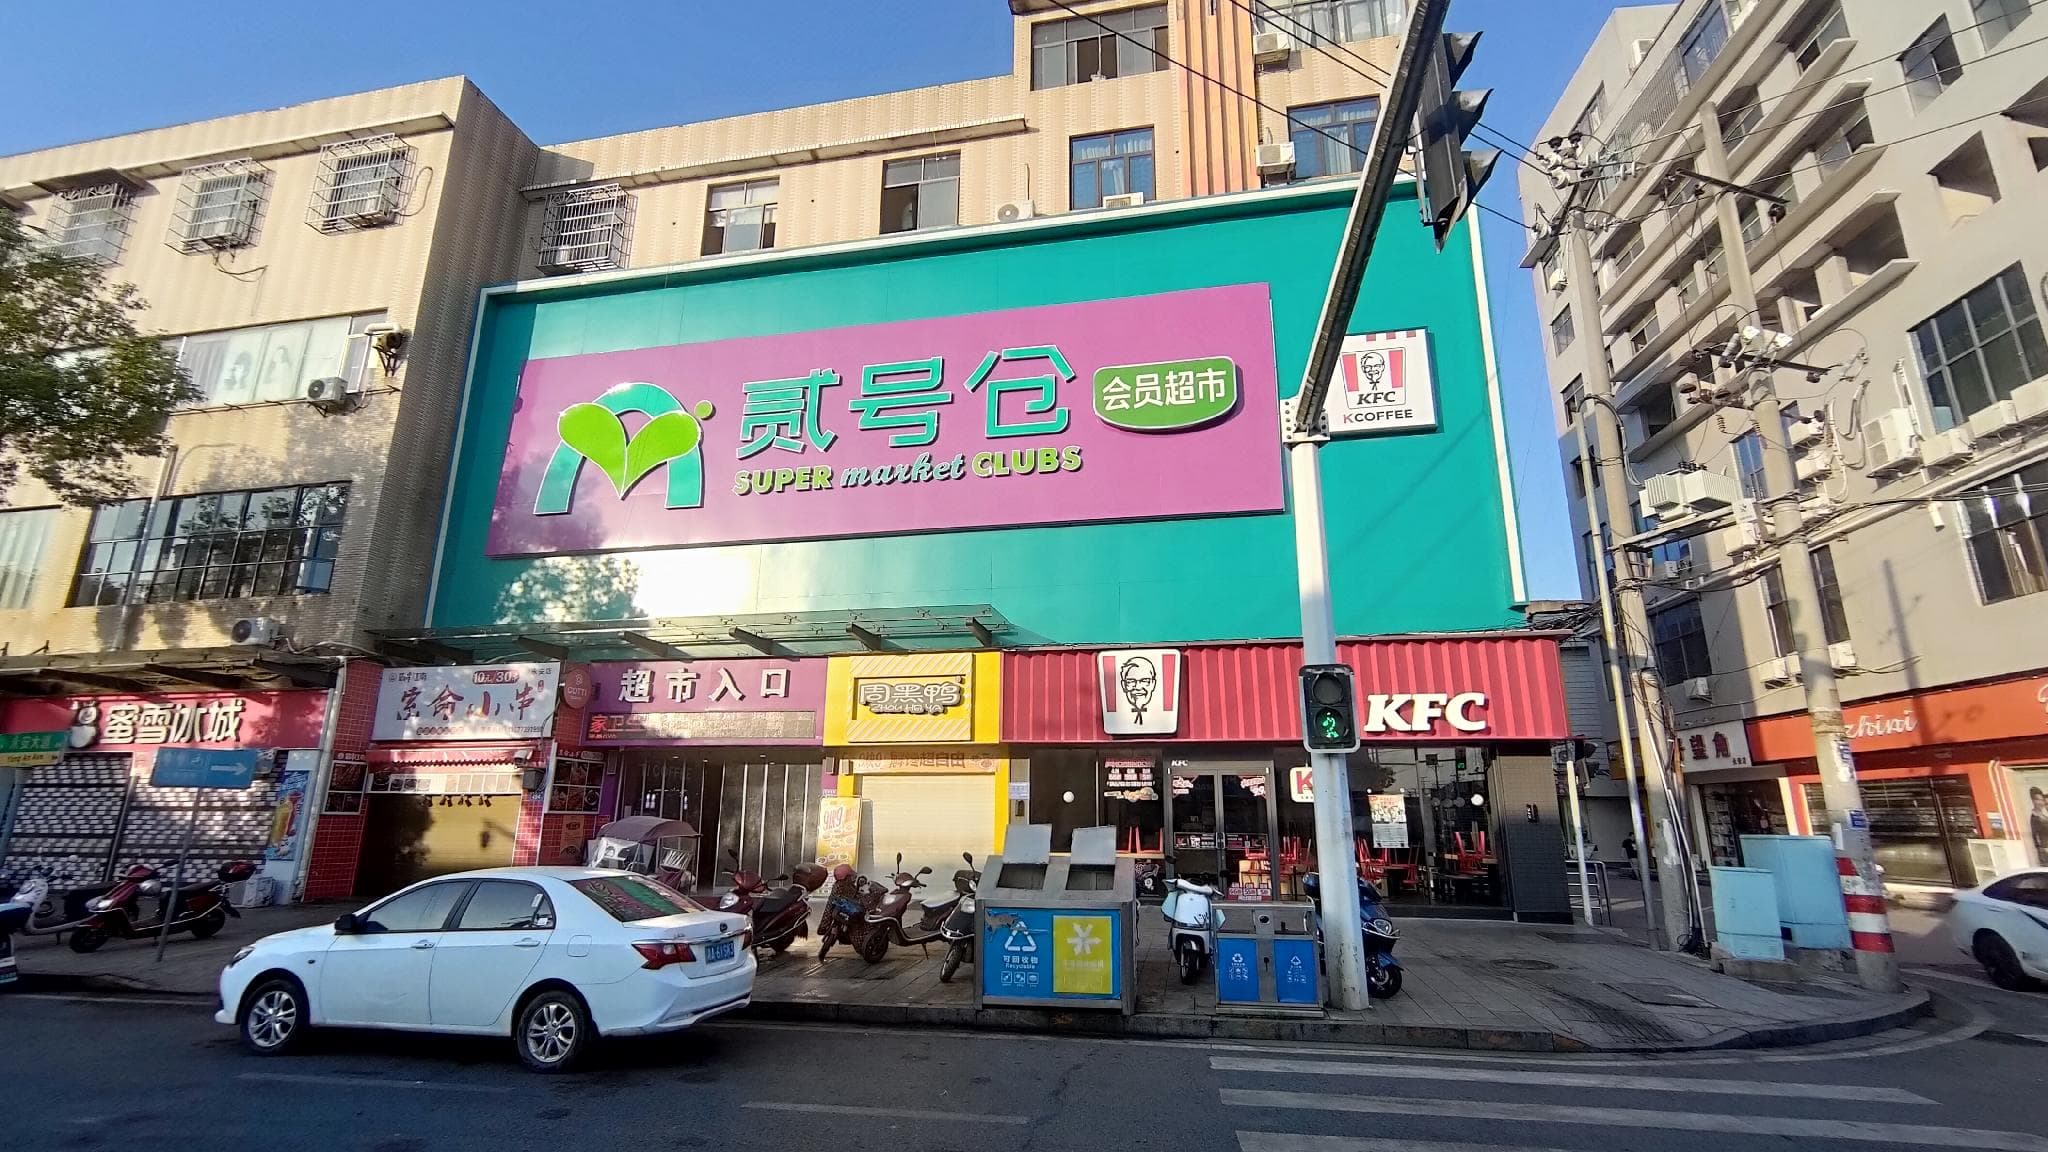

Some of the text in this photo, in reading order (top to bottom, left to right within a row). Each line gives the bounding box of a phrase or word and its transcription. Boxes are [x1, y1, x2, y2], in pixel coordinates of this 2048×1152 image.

[736, 344, 1076, 459] 贰号仓
[1101, 367, 1227, 410] 会员超市
[1357, 391, 1396, 405] KFC
[1343, 409, 1413, 424] KCOFFEE
[734, 445, 1083, 496] SUPER market CLUBS
[567, 686, 587, 697] COTTI
[618, 667, 790, 703] 超市入口
[859, 682, 962, 704] 周黑鸭
[100, 698, 246, 744] 蜜雪冰城
[870, 703, 903, 713] ZHOU
[1363, 691, 1487, 733] KFC
[1003, 955, 1039, 964] 可回收物
